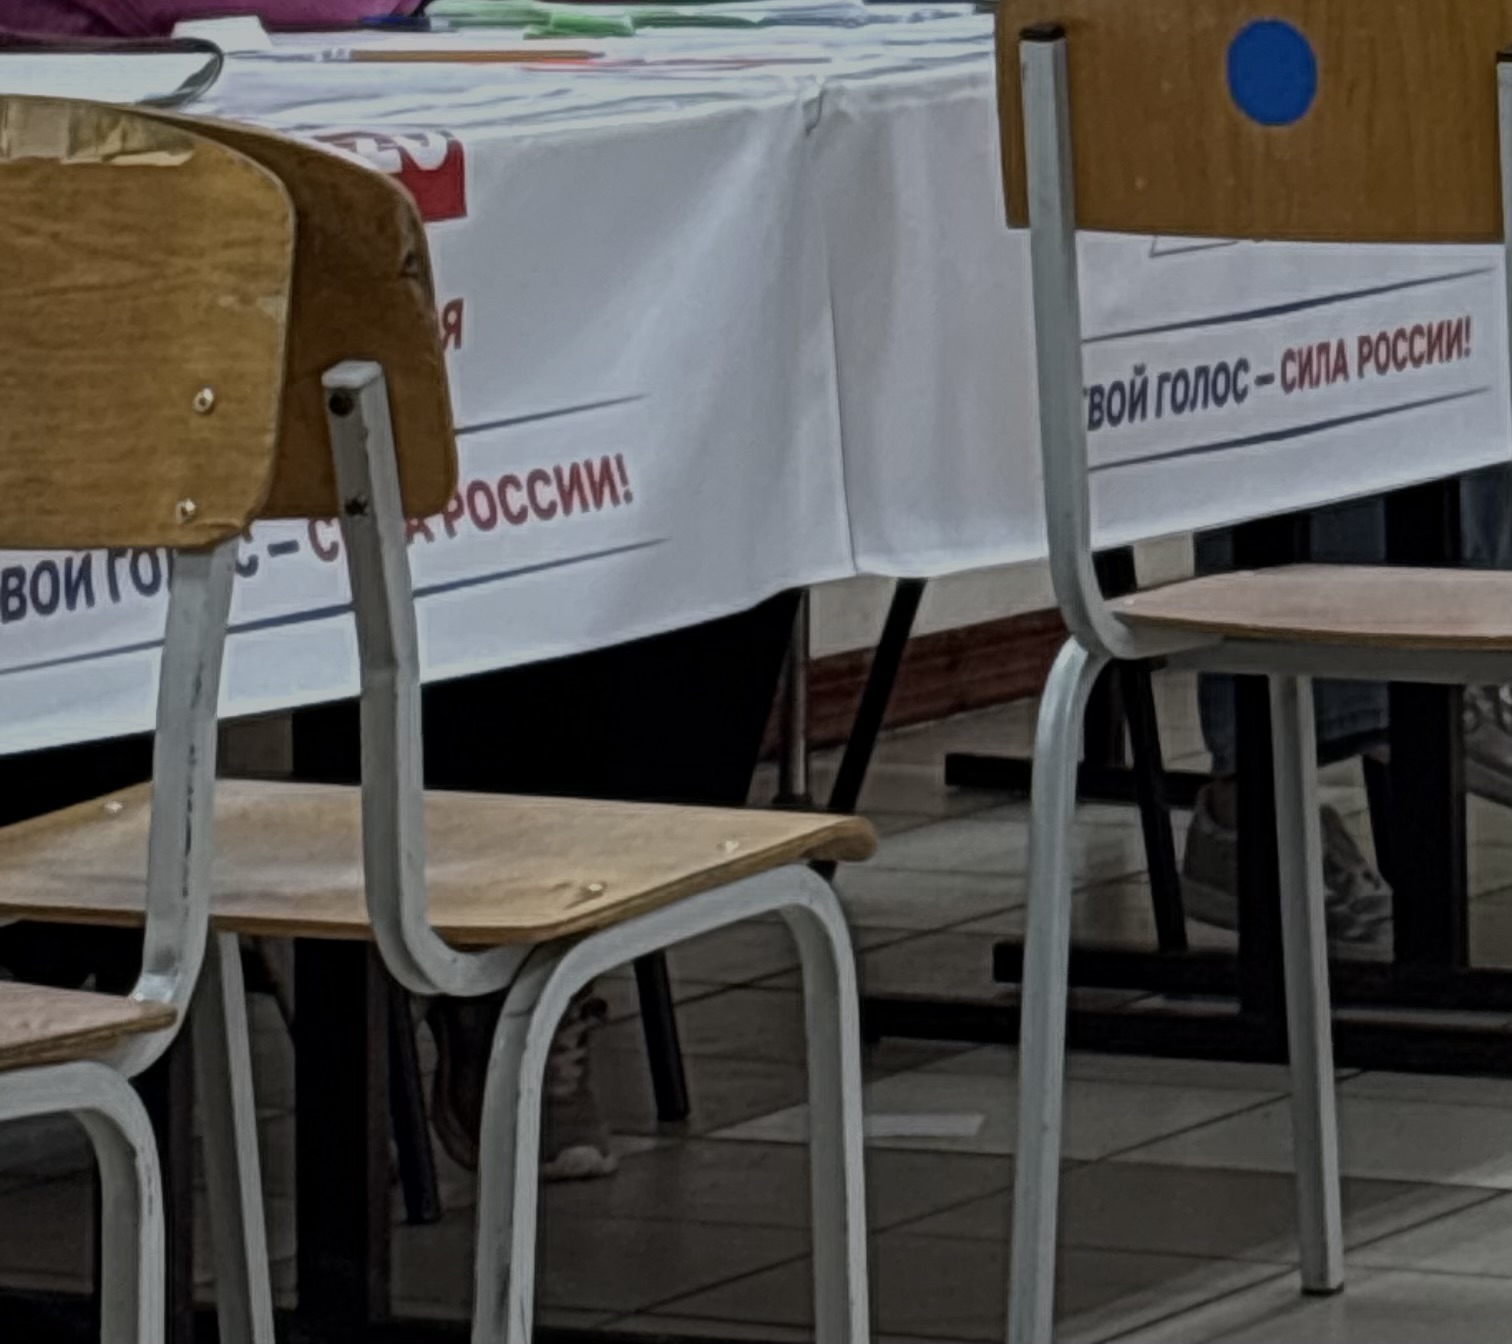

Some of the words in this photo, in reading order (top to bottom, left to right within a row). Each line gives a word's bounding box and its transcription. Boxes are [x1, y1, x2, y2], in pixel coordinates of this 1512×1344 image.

[1083, 363, 1149, 432] ВОЙ
[1155, 357, 1250, 419] ГОЛОС
[1280, 339, 1350, 394] СИЛА
[1356, 316, 1472, 379] РОССИИ!
[0, 553, 95, 624] ВОЙ
[442, 453, 633, 539] РОССИИ!
